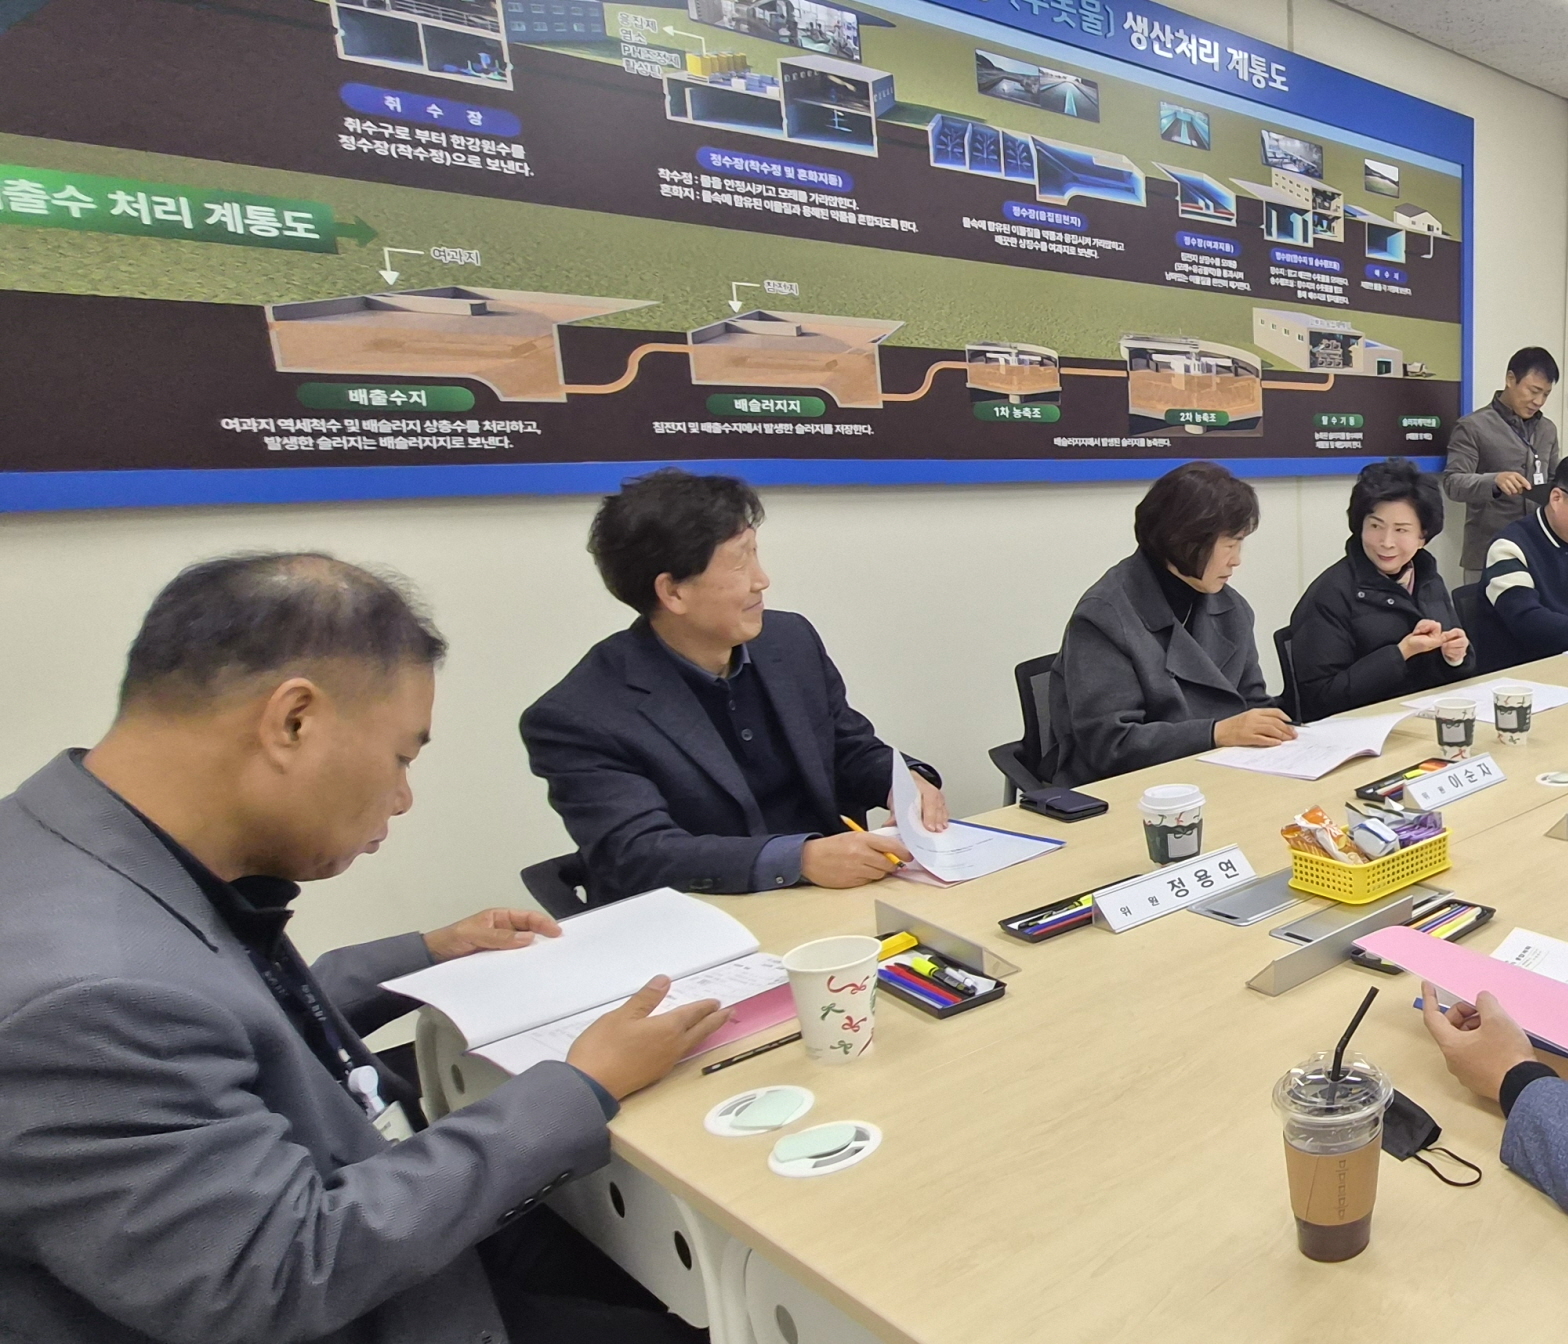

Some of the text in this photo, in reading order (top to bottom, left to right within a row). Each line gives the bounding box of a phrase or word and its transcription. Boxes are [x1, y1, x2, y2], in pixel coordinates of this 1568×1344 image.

[1123, 11, 1219, 71] 생산처리
[1226, 47, 1289, 92] 계통도
[343, 117, 526, 159] 취수구로 부터 한강원수를
[338, 134, 535, 177] 정수장(착수정)으로 보낸다.
[0, 179, 321, 239] 출수 처리 계통도
[431, 247, 481, 266] 여과지
[348, 389, 428, 407] 배출수지
[734, 398, 801, 413] 배슬러지지
[993, 406, 1042, 418] 1차 농축조
[220, 418, 276, 433] 여과지
[276, 418, 342, 433] 역세척수
[344, 418, 360, 433] 및
[362, 419, 421, 433] 배슬러지
[482, 420, 542, 435] 처리하고,
[652, 421, 687, 434] 침전지
[263, 435, 514, 451] 발생한 슬러지는 배슬러지지로 보낸다.
[1167, 858, 1240, 899] 정용연
